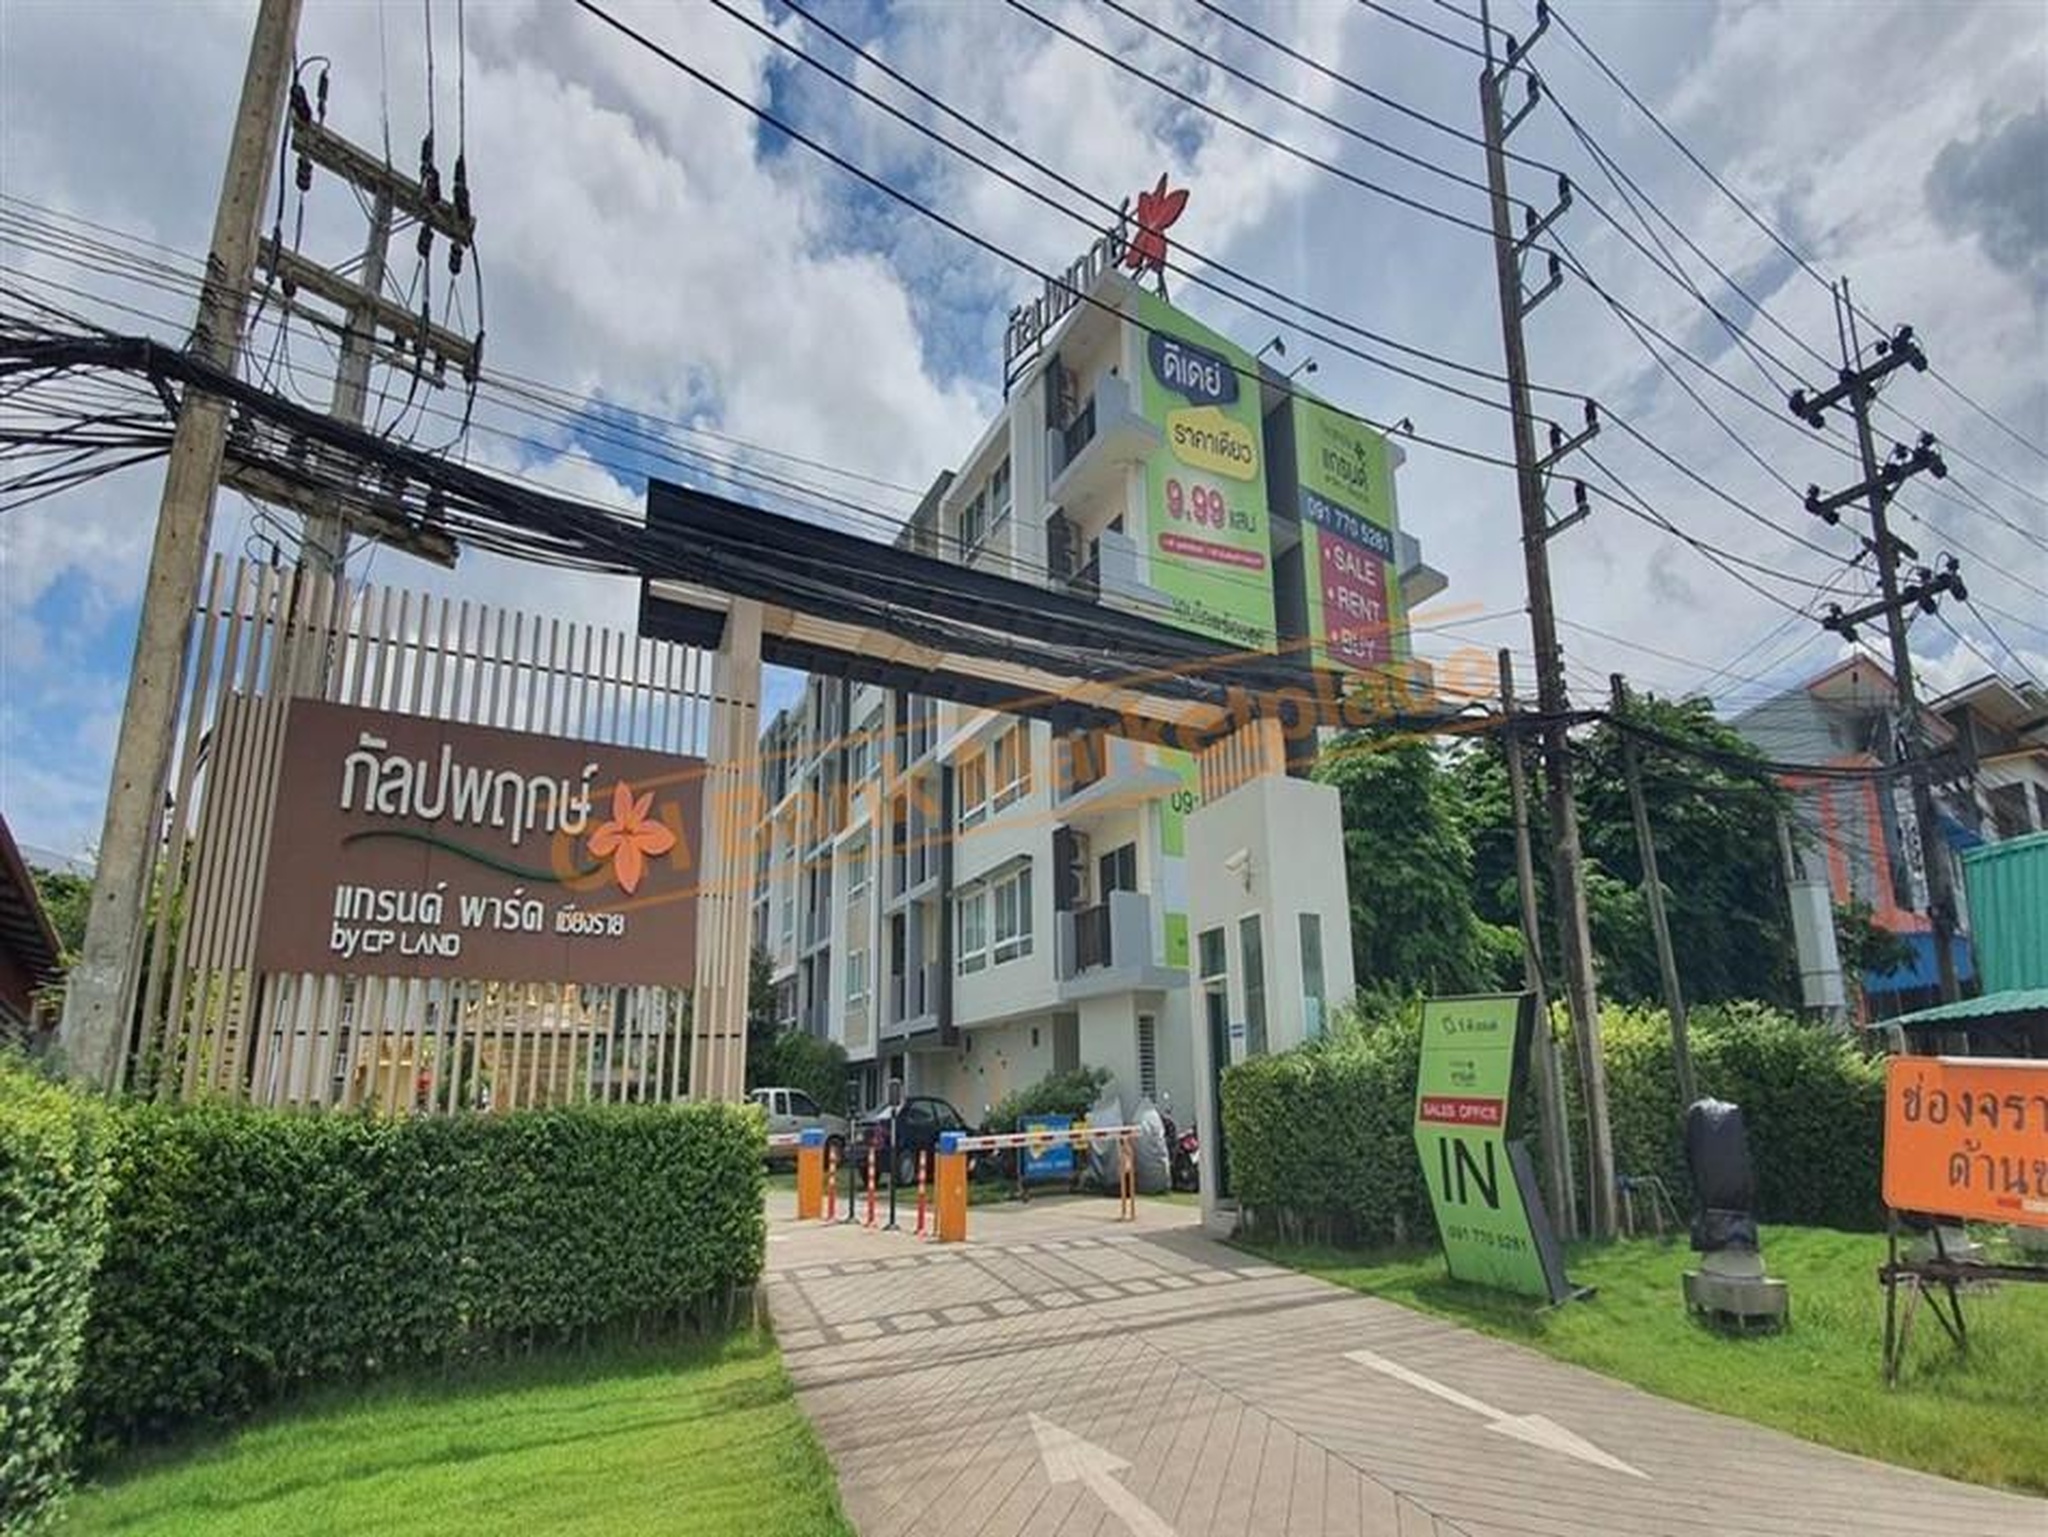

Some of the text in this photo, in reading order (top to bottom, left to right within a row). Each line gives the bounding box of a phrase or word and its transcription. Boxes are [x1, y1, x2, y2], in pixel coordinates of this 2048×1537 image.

[1333, 544, 1377, 587] SALE
[1337, 585, 1380, 622] RENT
[1341, 627, 1375, 660] BUY
[333, 881, 447, 926] แกรนด์
[331, 922, 460, 958] by CP LAND
[1422, 1102, 1498, 1120] SALES OFFICE
[1438, 1137, 1499, 1210] IN
